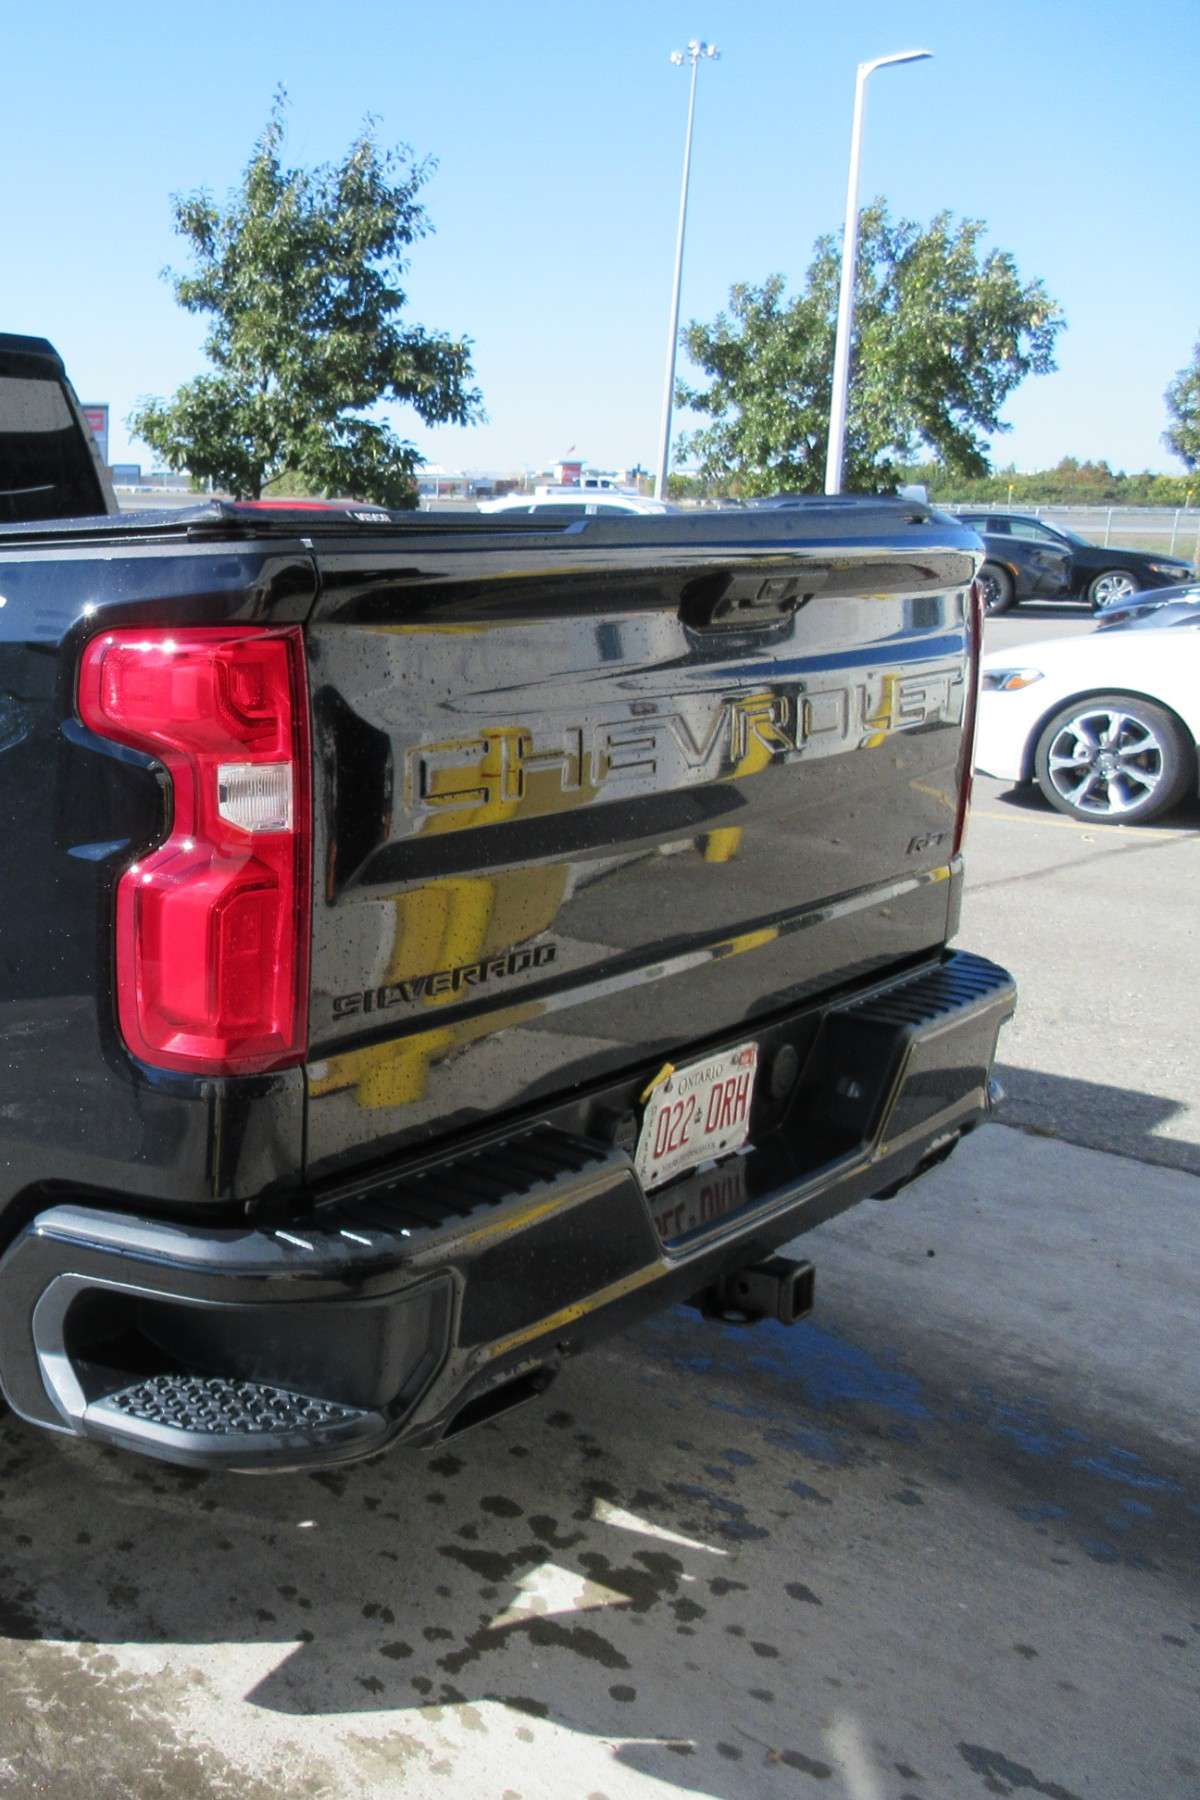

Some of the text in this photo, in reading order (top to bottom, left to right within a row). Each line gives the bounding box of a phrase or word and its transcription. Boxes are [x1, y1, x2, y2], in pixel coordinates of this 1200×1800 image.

[404, 664, 964, 818] CHEVROLET
[332, 942, 558, 1021] SILVERADO
[677, 1063, 724, 1097] ONTARIO
